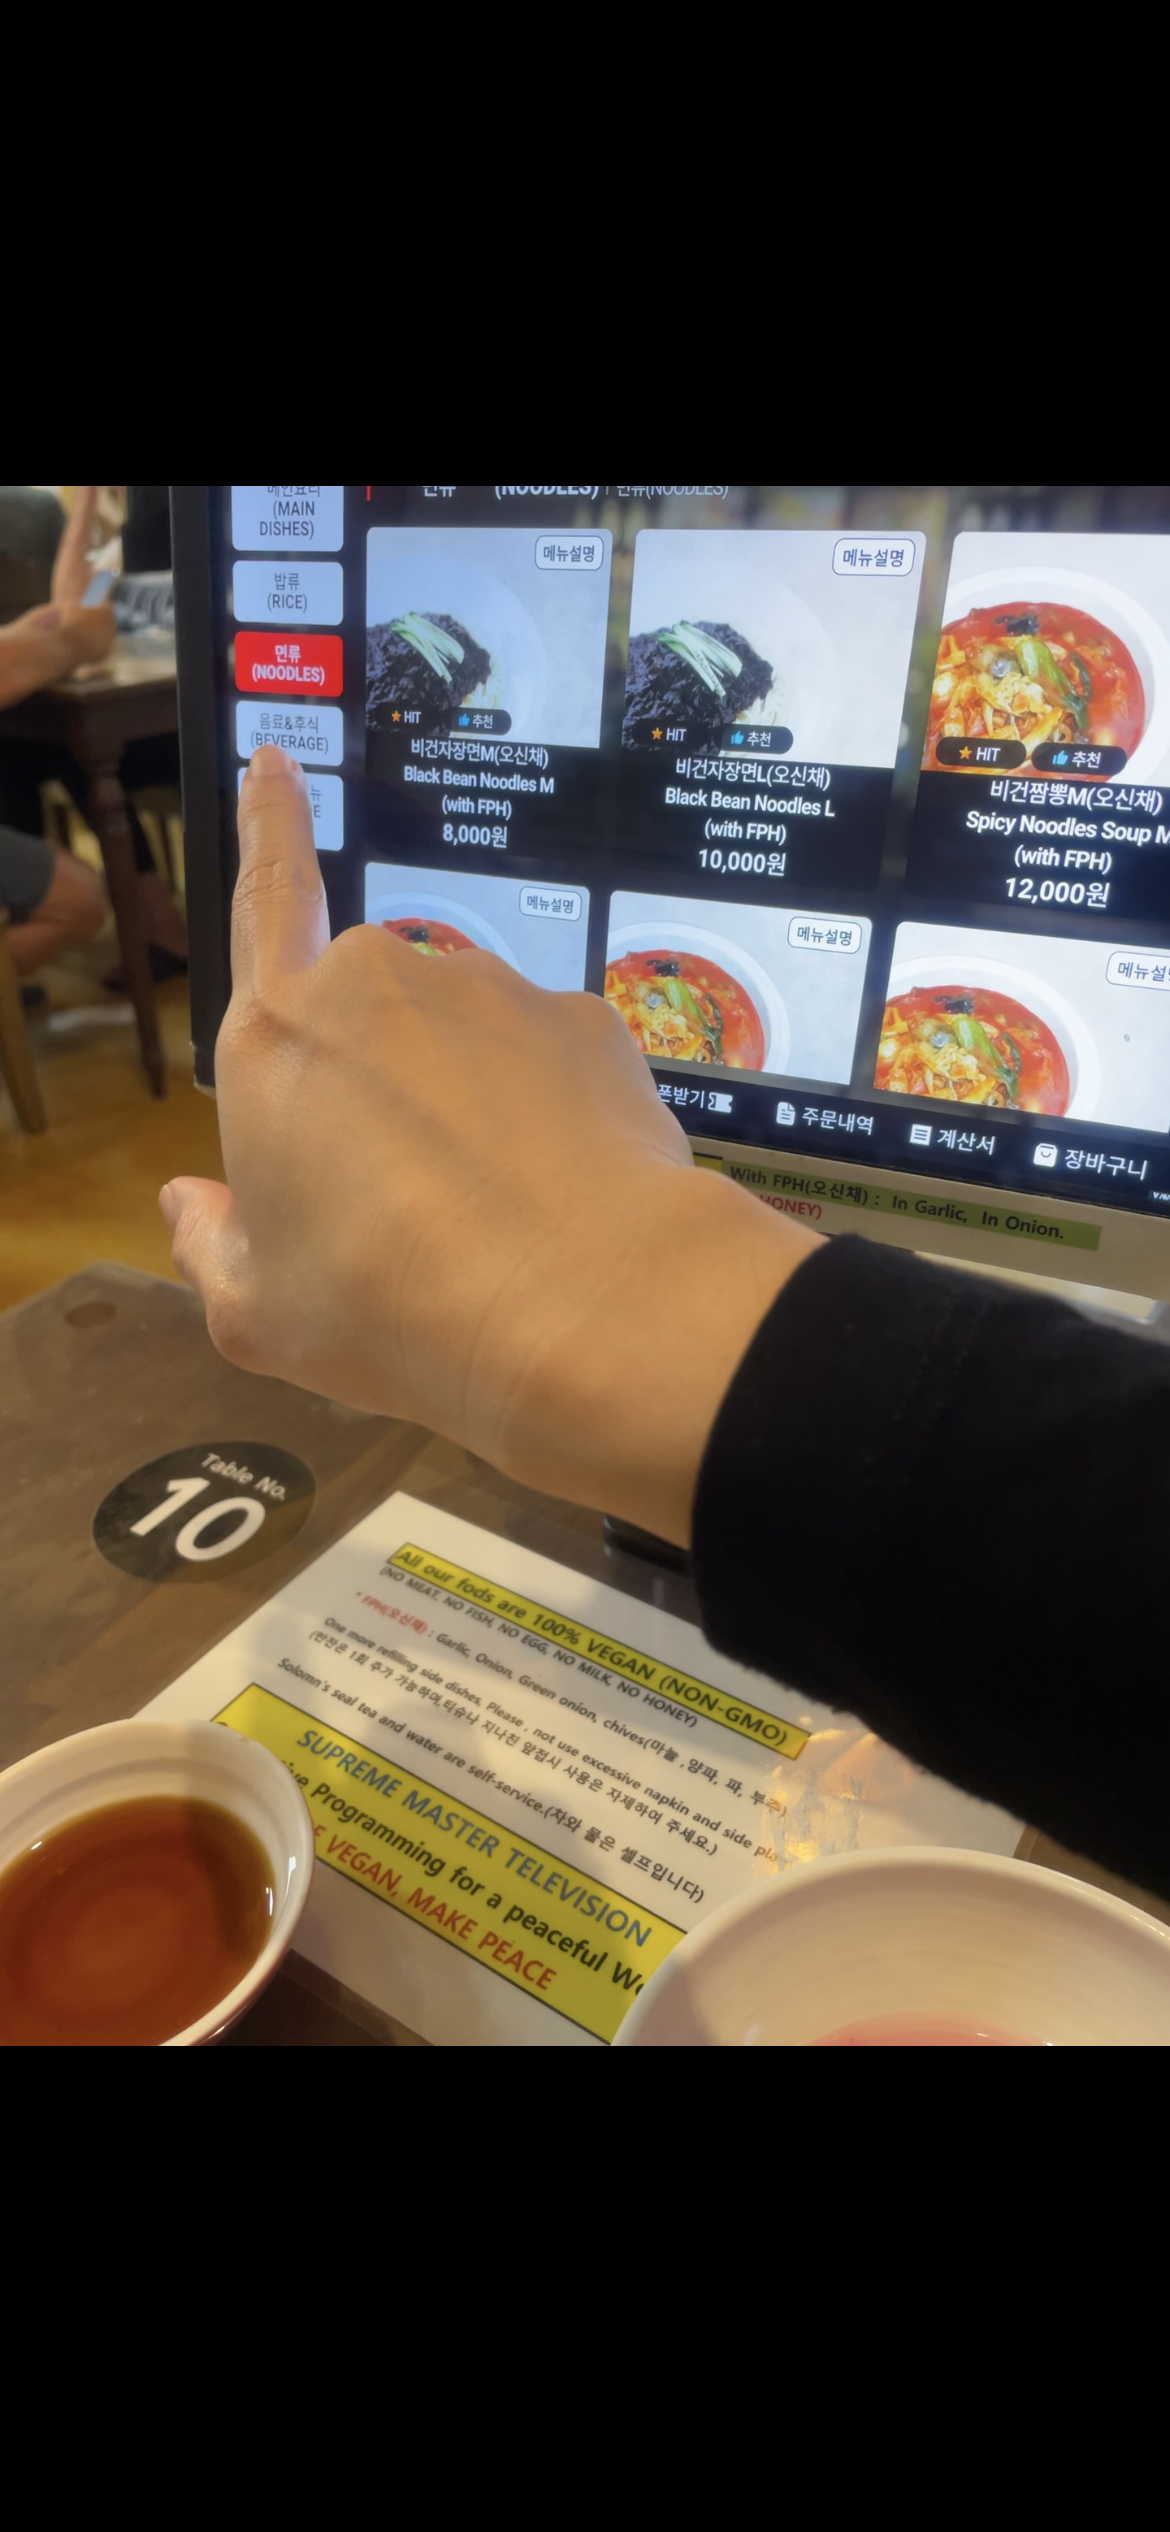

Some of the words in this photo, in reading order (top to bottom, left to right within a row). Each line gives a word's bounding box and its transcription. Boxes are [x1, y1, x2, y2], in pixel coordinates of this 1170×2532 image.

[273, 500, 315, 520] (MAIN
[259, 520, 314, 540] DISHES)
[543, 545, 595, 563] 메뉴설명
[842, 548, 904, 568] 메뉴설명
[274, 573, 300, 591] 밥류
[267, 593, 308, 612] (RICE)
[275, 645, 301, 663] 면류
[252, 656, 326, 686] (NOODLES)
[259, 713, 319, 734] 음료&후식
[404, 711, 422, 724] HIT
[472, 714, 494, 729] 추천
[250, 731, 329, 755] (BEVERAGE)
[666, 728, 687, 742] HIT
[747, 732, 772, 747] 추천
[411, 738, 549, 769] 비건자장면M(오신채)
[976, 746, 1001, 762] HIT
[1071, 751, 1101, 769] 추천
[404, 766, 440, 785] Black
[443, 769, 477, 787] Bean
[480, 773, 537, 792] Noodles
[540, 778, 555, 793] M
[676, 757, 831, 791] 비건자장면L(오신채)
[442, 795, 475, 815] (with
[478, 799, 512, 821] FPH)
[665, 787, 707, 807] Black
[710, 790, 750, 810] Bean
[754, 795, 821, 816] Noodles
[824, 800, 835, 817] L
[990, 779, 1163, 816] 비건짬뽕M(오신채)
[443, 823, 508, 848] 8,000원
[704, 818, 743, 839] (with
[746, 822, 787, 846] FPH)
[966, 811, 1016, 836] Spicy
[1020, 814, 1097, 838] Noodles
[1101, 821, 1151, 846] Soup
[1155, 826, 1170, 844] M
[699, 849, 786, 876] 10,000원
[1014, 844, 1060, 867] (with
[1064, 850, 1112, 875] FPH)
[526, 895, 574, 914] 메뉴설명
[1005, 877, 1110, 908] 12,000원
[797, 926, 852, 946] 메뉴설명
[1117, 961, 1170, 982] 메뉴설
[658, 1084, 705, 1109] 폰받기
[802, 1107, 874, 1136] 주문내역
[937, 1129, 996, 1155] 계산서
[1064, 1149, 1148, 1181] 장바구니
[730, 1166, 767, 1185] With
[773, 1174, 868, 1205] FPH(오신채)
[892, 1195, 908, 1211] In
[914, 1200, 968, 1223] Garlic,
[981, 1211, 998, 1226] In
[1005, 1216, 1064, 1239] Onion.
[201, 1452, 254, 1485] Table
[255, 1476, 286, 1501] No.
[130, 1477, 266, 1561] 10
[379, 1566, 405, 1582] (NO
[405, 1578, 440, 1602] MEAT,
[443, 1596, 465, 1612] NO
[465, 1606, 495, 1628] FISH,
[498, 1622, 520, 1639] NO
[521, 1634, 548, 1656] EGG,
[553, 1648, 576, 1667] NO
[577, 1661, 612, 1688] MILK,
[616, 1681, 641, 1698] NO
[642, 1693, 699, 1728] HONEY)
[396, 1549, 424, 1568] All
[423, 1564, 455, 1583] our
[455, 1577, 496, 1604] fods
[497, 1597, 527, 1619] are
[532, 1613, 580, 1645] 100%
[587, 1638, 657, 1681] VEGAN
[658, 1675, 788, 1747] (NON-GMO)
[435, 1632, 471, 1659] Garlic,
[475, 1652, 514, 1680] Onion,
[518, 1673, 556, 1700] Green
[558, 1697, 597, 1723] onion,
[324, 1617, 346, 1633] One
[347, 1630, 376, 1649] more
[419, 1668, 444, 1685] side
[445, 1680, 482, 1707] dishes,
[485, 1701, 524, 1727] Please
[532, 1728, 556, 1744] not
[557, 1741, 580, 1757] use
[582, 1754, 642, 1790] excessive
[643, 1785, 690, 1816] napkin
[691, 1808, 722, 1833] and
[722, 1825, 752, 1849] side
[331, 1689, 359, 1707] seal
[357, 1702, 378, 1719] tea
[378, 1714, 407, 1734] and
[406, 1729, 443, 1755] water
[443, 1750, 466, 1769] are
[583, 1826, 616, 1852] 물은
[620, 1846, 704, 1904] 셀프입니다)
[481, 1719, 521, 1747] 지나친
[562, 1764, 604, 1793] 사용은
[606, 1787, 663, 1825] 자제하여
[665, 1818, 719, 1857] 주세요.)
[297, 1729, 403, 1799] SUPREME
[401, 1790, 500, 1858] MASTER
[504, 1847, 652, 1948] TELEVISION
[311, 1782, 447, 1878] Programming
[449, 1866, 486, 1897] for
[486, 1893, 503, 1910] a
[502, 1903, 608, 1973] peaceful
[325, 1834, 403, 1898] VEGAN,
[407, 1887, 479, 1941] MAKE
[477, 1930, 557, 1992] PEACE
